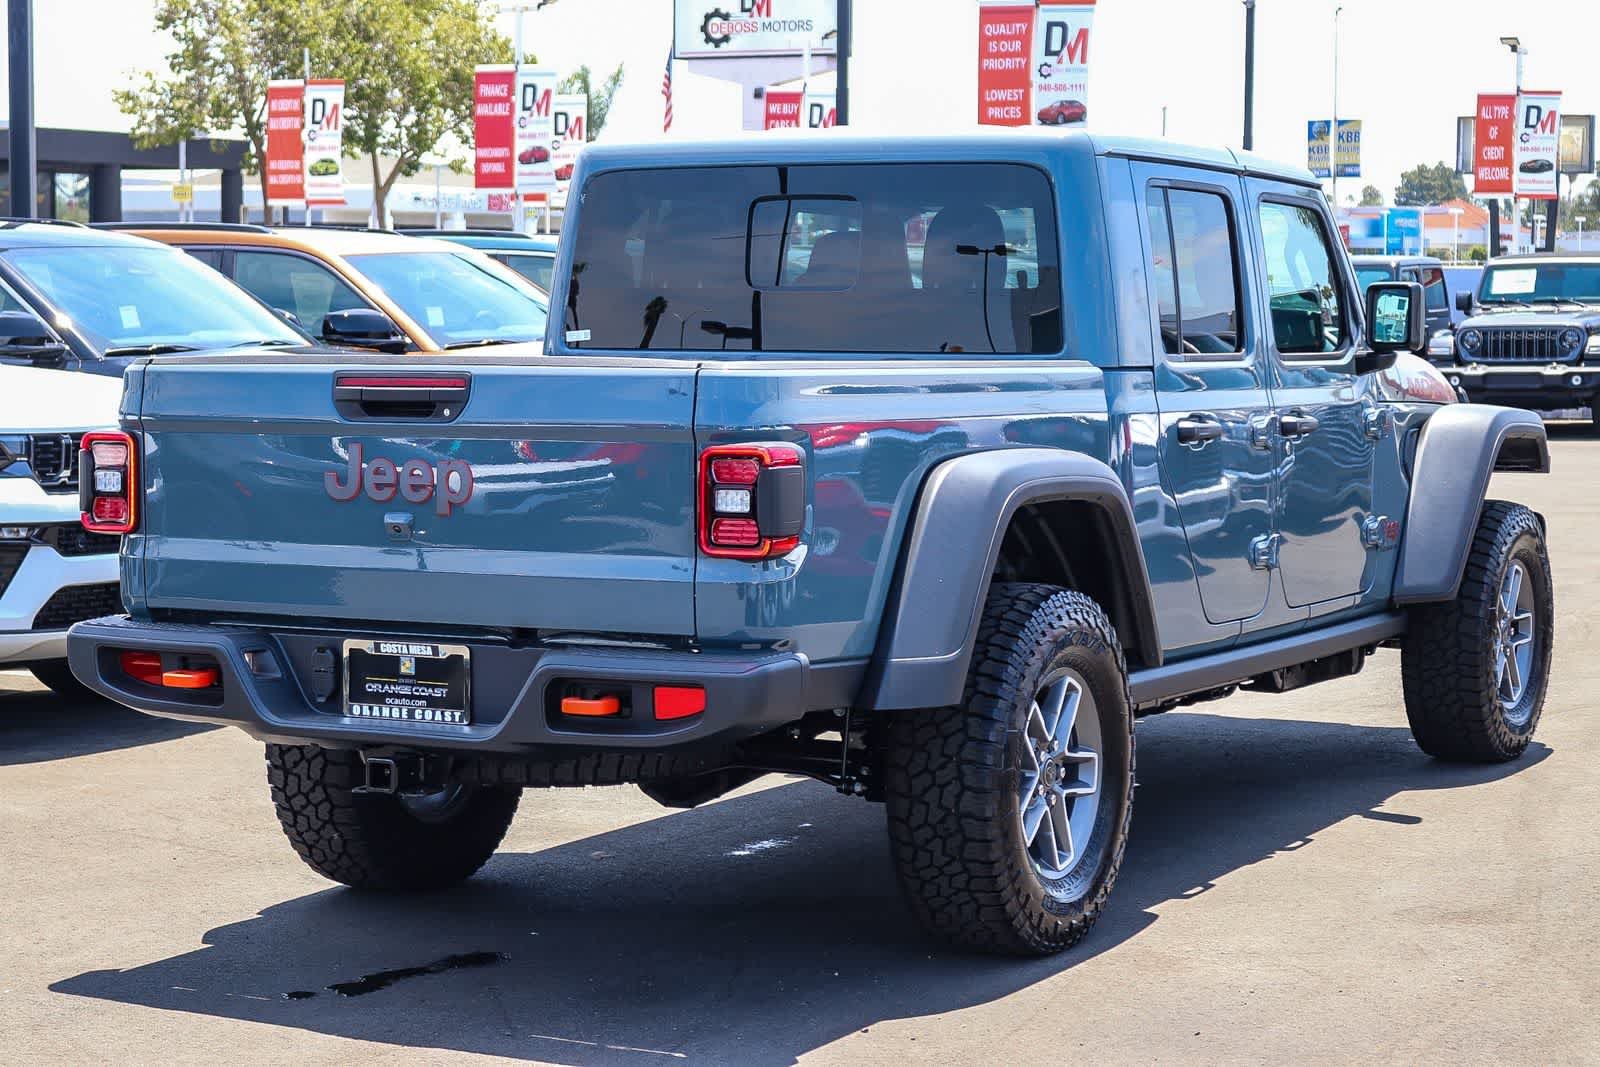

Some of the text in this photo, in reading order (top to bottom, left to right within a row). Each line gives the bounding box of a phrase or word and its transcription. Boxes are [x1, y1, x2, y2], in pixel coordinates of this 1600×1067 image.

[711, 20, 813, 34] DEBOSS MOTORS
[985, 23, 1028, 36] QUALITY
[990, 40, 1022, 53] IS OUR
[1044, 21, 1090, 65] DM
[983, 58, 1027, 70] PRIORITY
[480, 83, 509, 97] FINANCE
[985, 89, 1024, 102] LOWEST
[522, 83, 553, 118] DM
[312, 98, 340, 131] DM
[476, 102, 511, 117] AVAILABLE
[769, 103, 799, 114] WE BUY
[988, 106, 1022, 119] PRICES
[1481, 105, 1510, 120] ALL TYPE
[554, 111, 584, 141] DM
[1524, 105, 1557, 135] DM
[1489, 126, 1499, 140] OF
[1483, 146, 1504, 160] CREDIT
[1478, 167, 1510, 181] WELCOME
[323, 441, 475, 517] Jeep
[380, 642, 433, 656] COSTA MESA
[365, 682, 449, 698] ORANGE COAST
[385, 697, 427, 707] ocauto.com
[352, 704, 461, 722] ORANGE COAST
